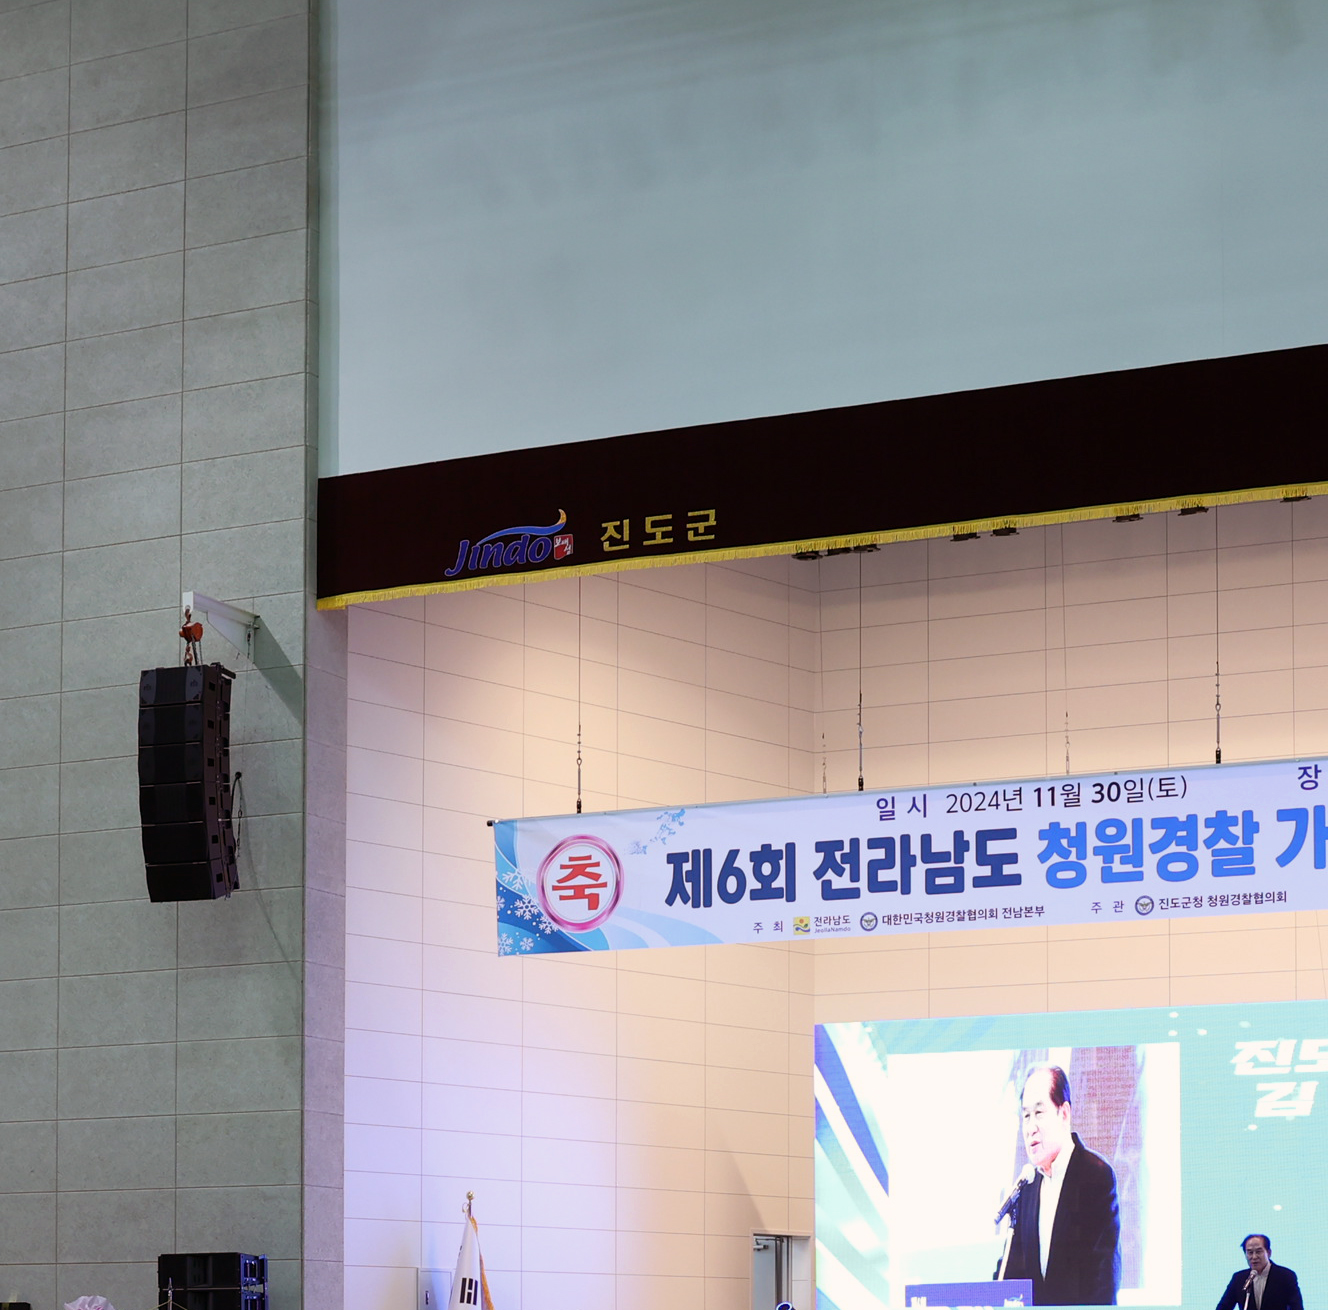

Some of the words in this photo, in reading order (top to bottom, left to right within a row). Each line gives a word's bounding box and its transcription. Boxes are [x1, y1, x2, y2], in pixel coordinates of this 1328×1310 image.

[599, 508, 717, 552] 진도군
[444, 526, 553, 577] Jindo
[945, 786, 1023, 814] 2024년
[1033, 782, 1082, 808] 11월
[1090, 774, 1188, 804] 30일(토)
[664, 838, 795, 910] 제6회
[811, 827, 1023, 899] 전라남도
[1036, 812, 1260, 886] 청원경찰
[551, 853, 608, 913] 축
[1158, 895, 1204, 911] 진도군청
[1207, 890, 1288, 907] 청원경찰협의회
[813, 914, 851, 926] 전라남도
[882, 907, 999, 926] 대한민국청원경찰협의회
[1001, 905, 1045, 919] 전남본부
